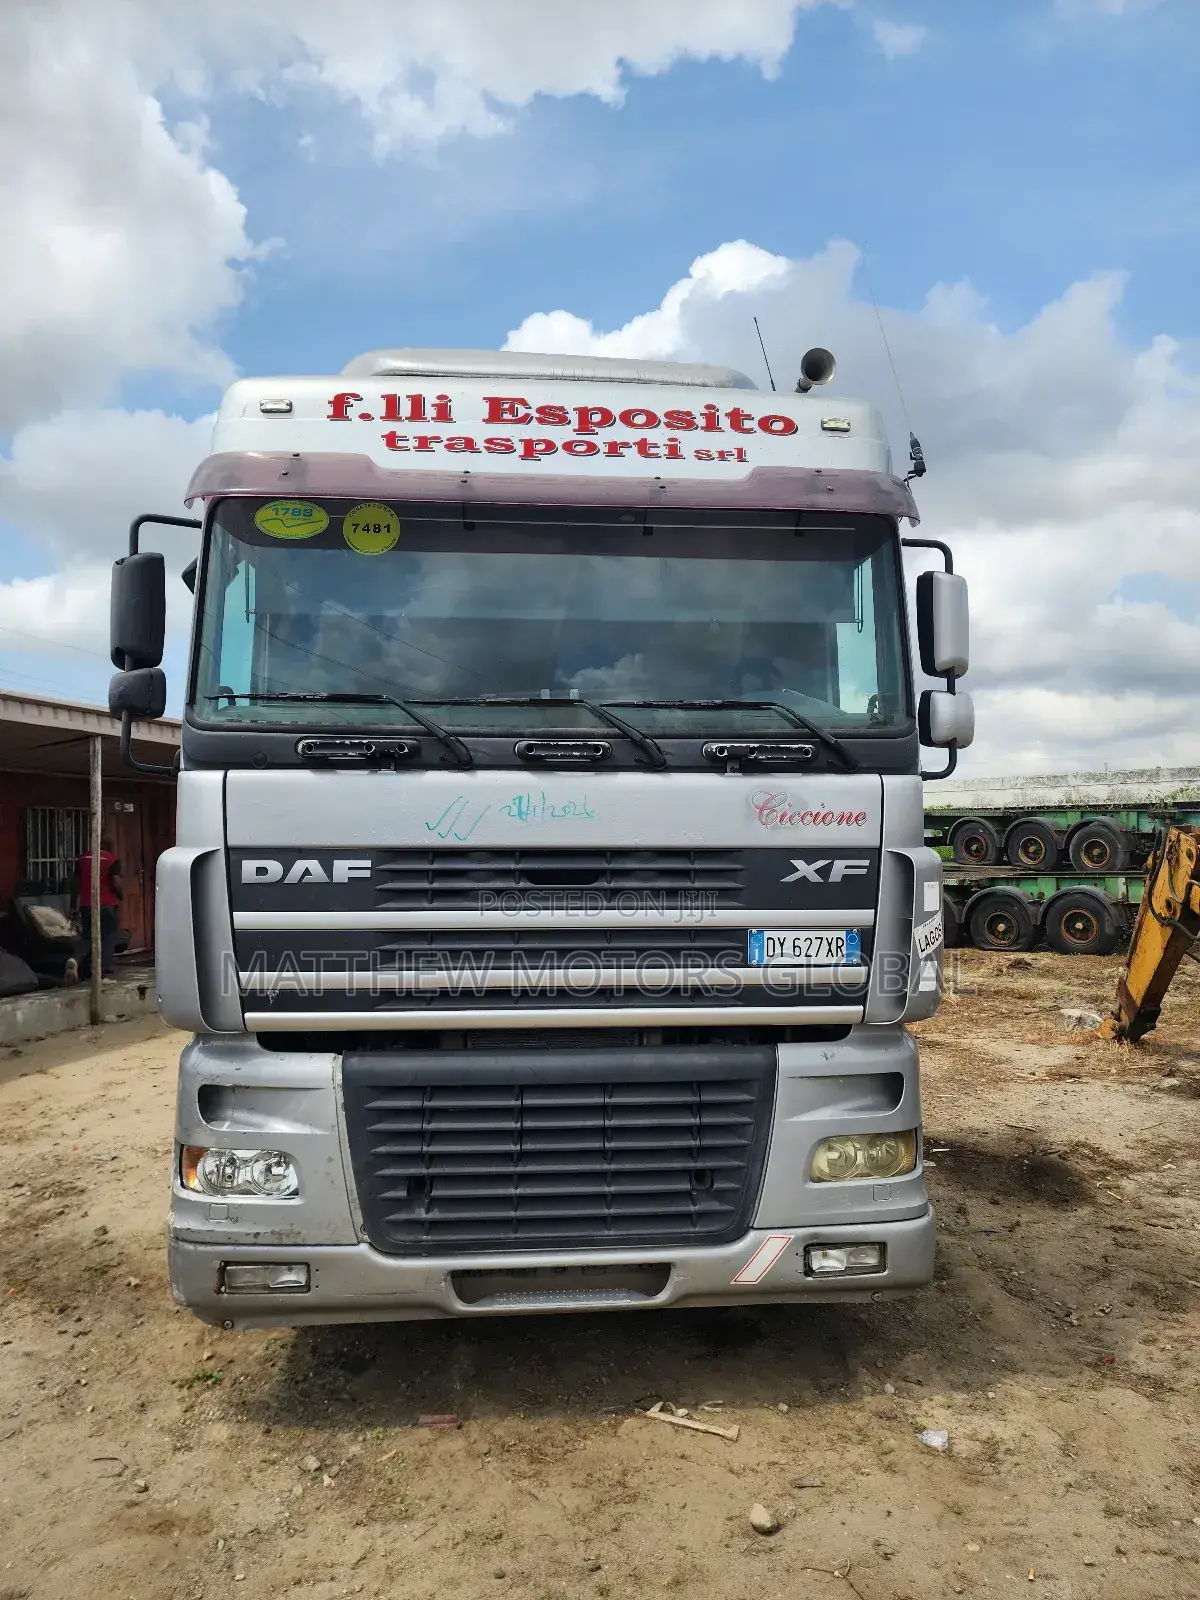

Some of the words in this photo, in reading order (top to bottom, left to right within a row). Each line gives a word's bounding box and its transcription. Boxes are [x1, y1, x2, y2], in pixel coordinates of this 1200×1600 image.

[327, 392, 456, 423] f.lli
[482, 396, 799, 435] Esposito
[381, 430, 686, 461] trasporti
[693, 446, 749, 463] srl
[351, 523, 391, 534] 7481
[752, 791, 868, 829] Ciccione
[241, 859, 372, 884] DAF
[780, 859, 871, 883] XF
[766, 936, 787, 958] DY
[792, 936, 845, 958] 627XR
